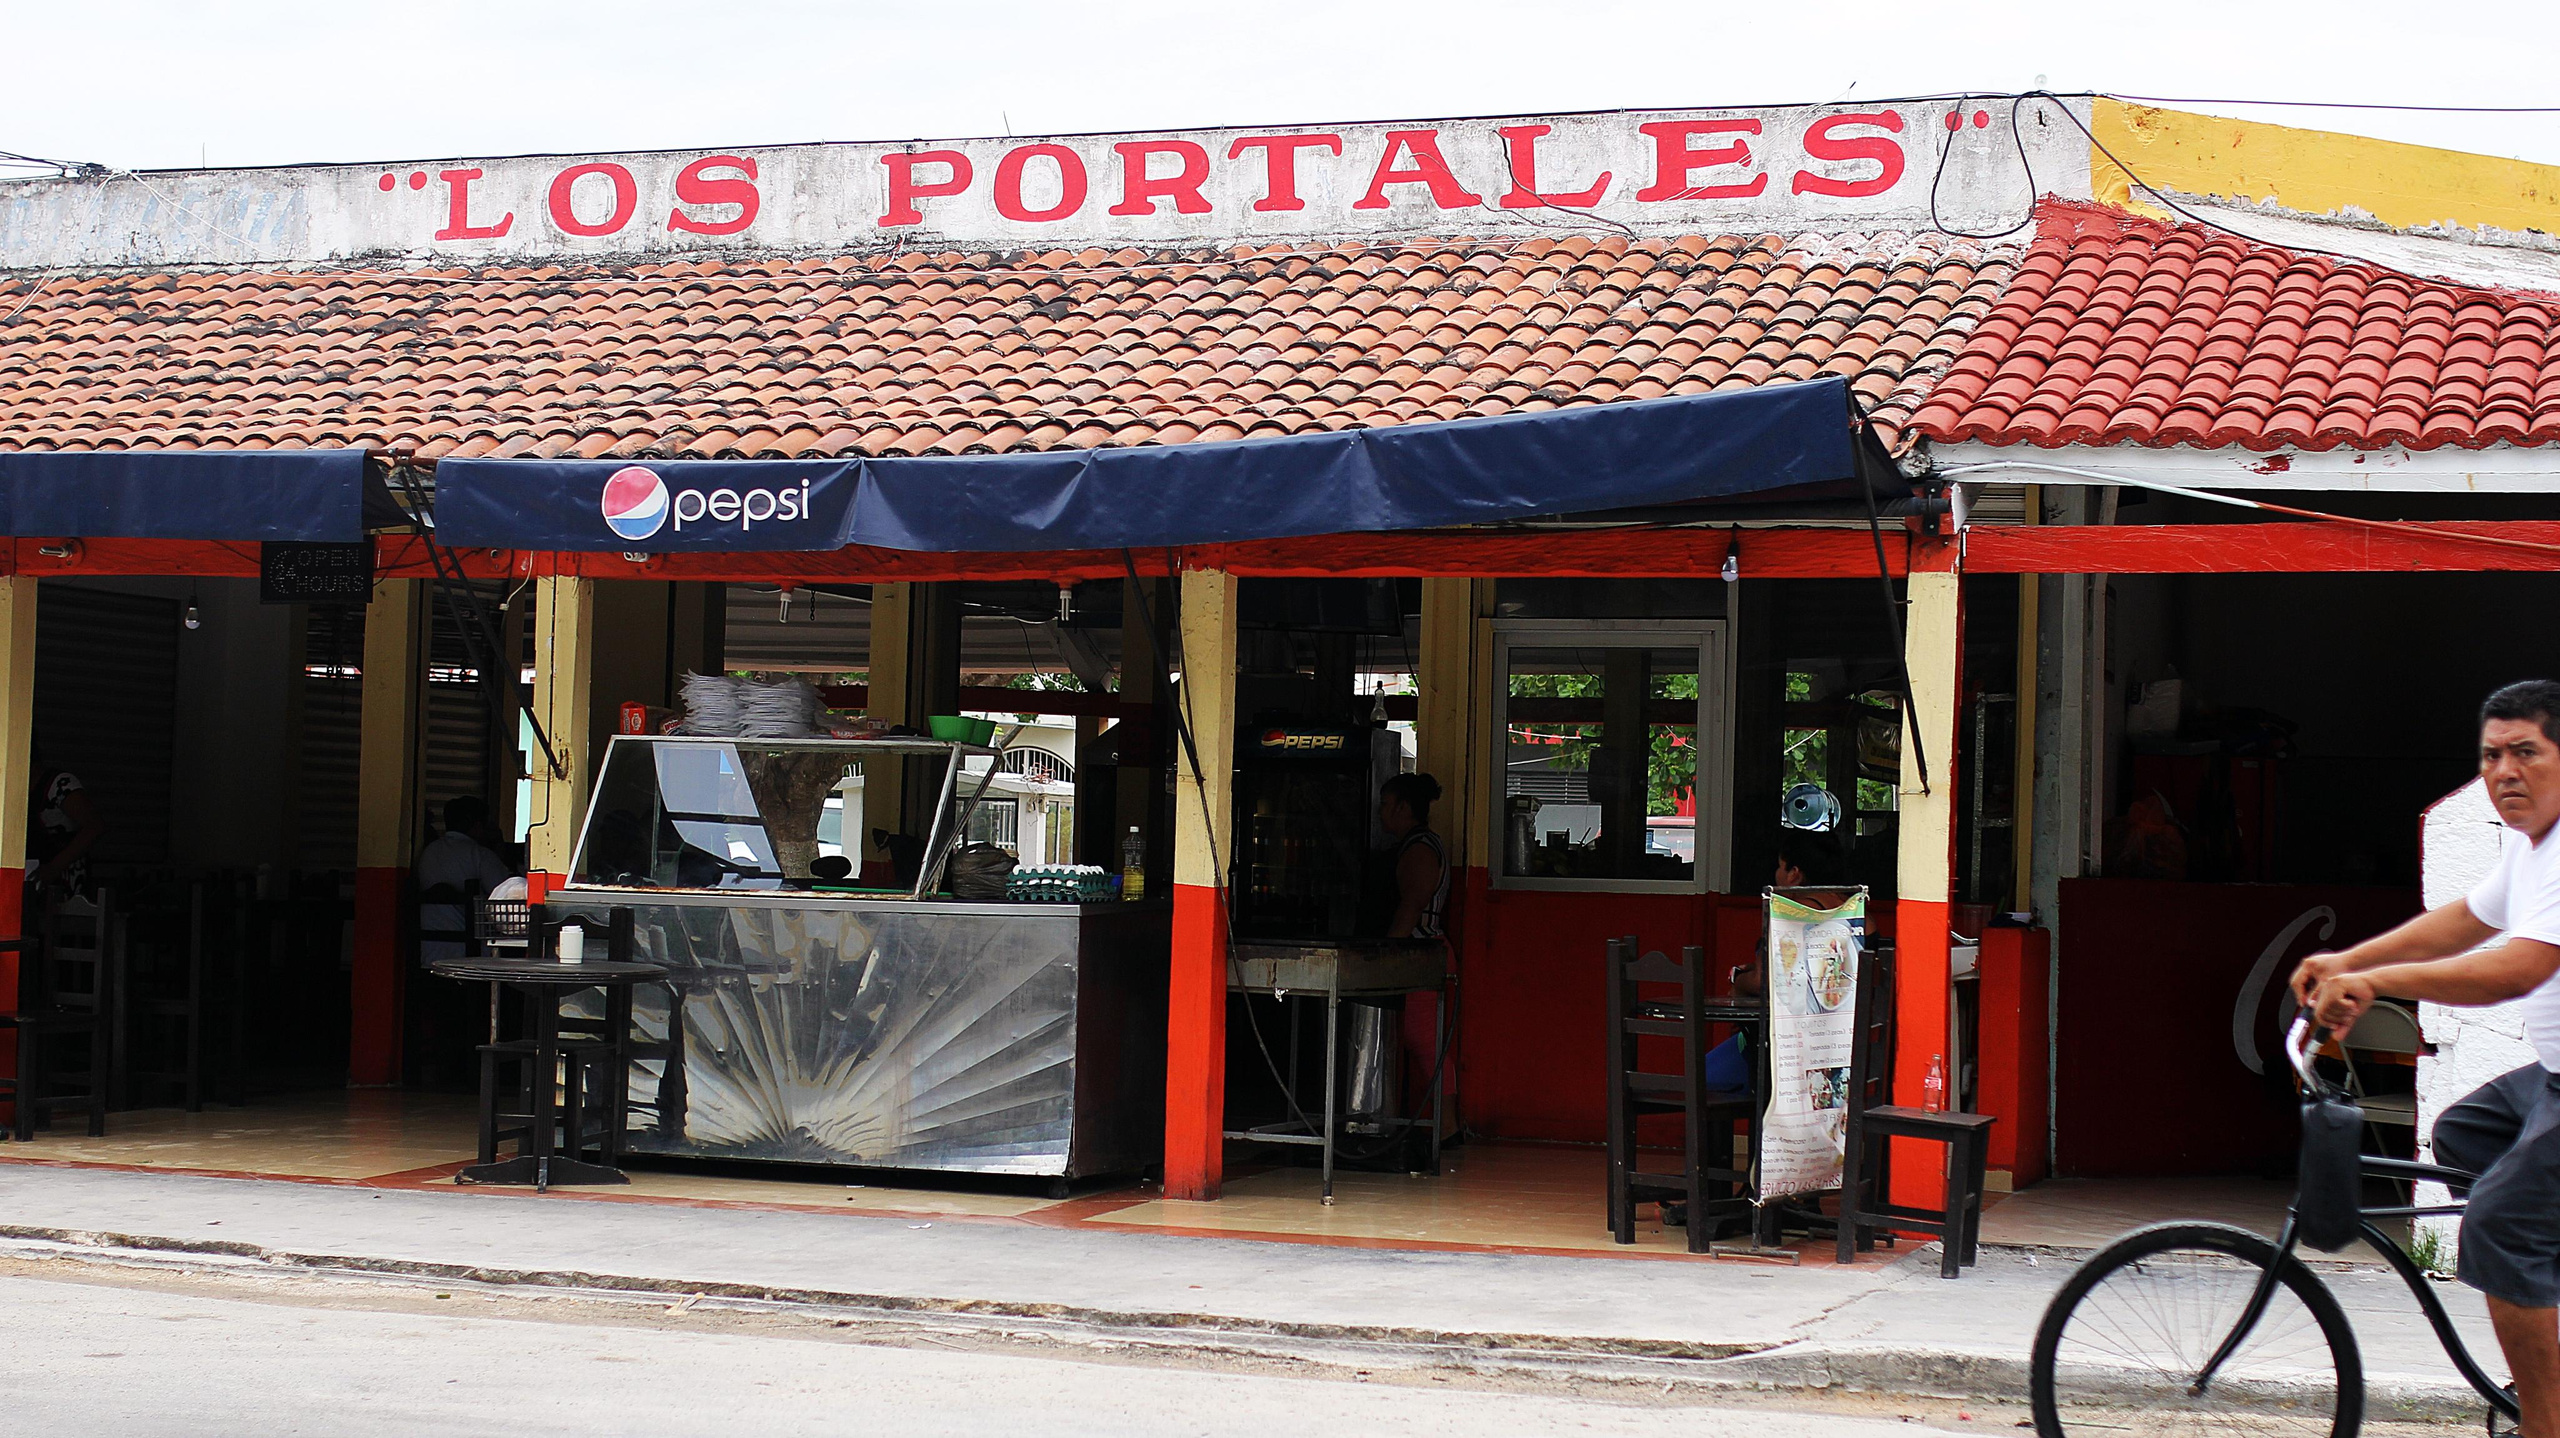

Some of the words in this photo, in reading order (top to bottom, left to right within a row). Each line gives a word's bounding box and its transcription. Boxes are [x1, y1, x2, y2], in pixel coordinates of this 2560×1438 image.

[674, 478, 810, 532] pepsi
[297, 549, 360, 567] OPEN
[295, 575, 365, 593] HOURS
[1283, 735, 1345, 749] PEPSI
[1760, 1180, 1796, 1196] ERVICIO
